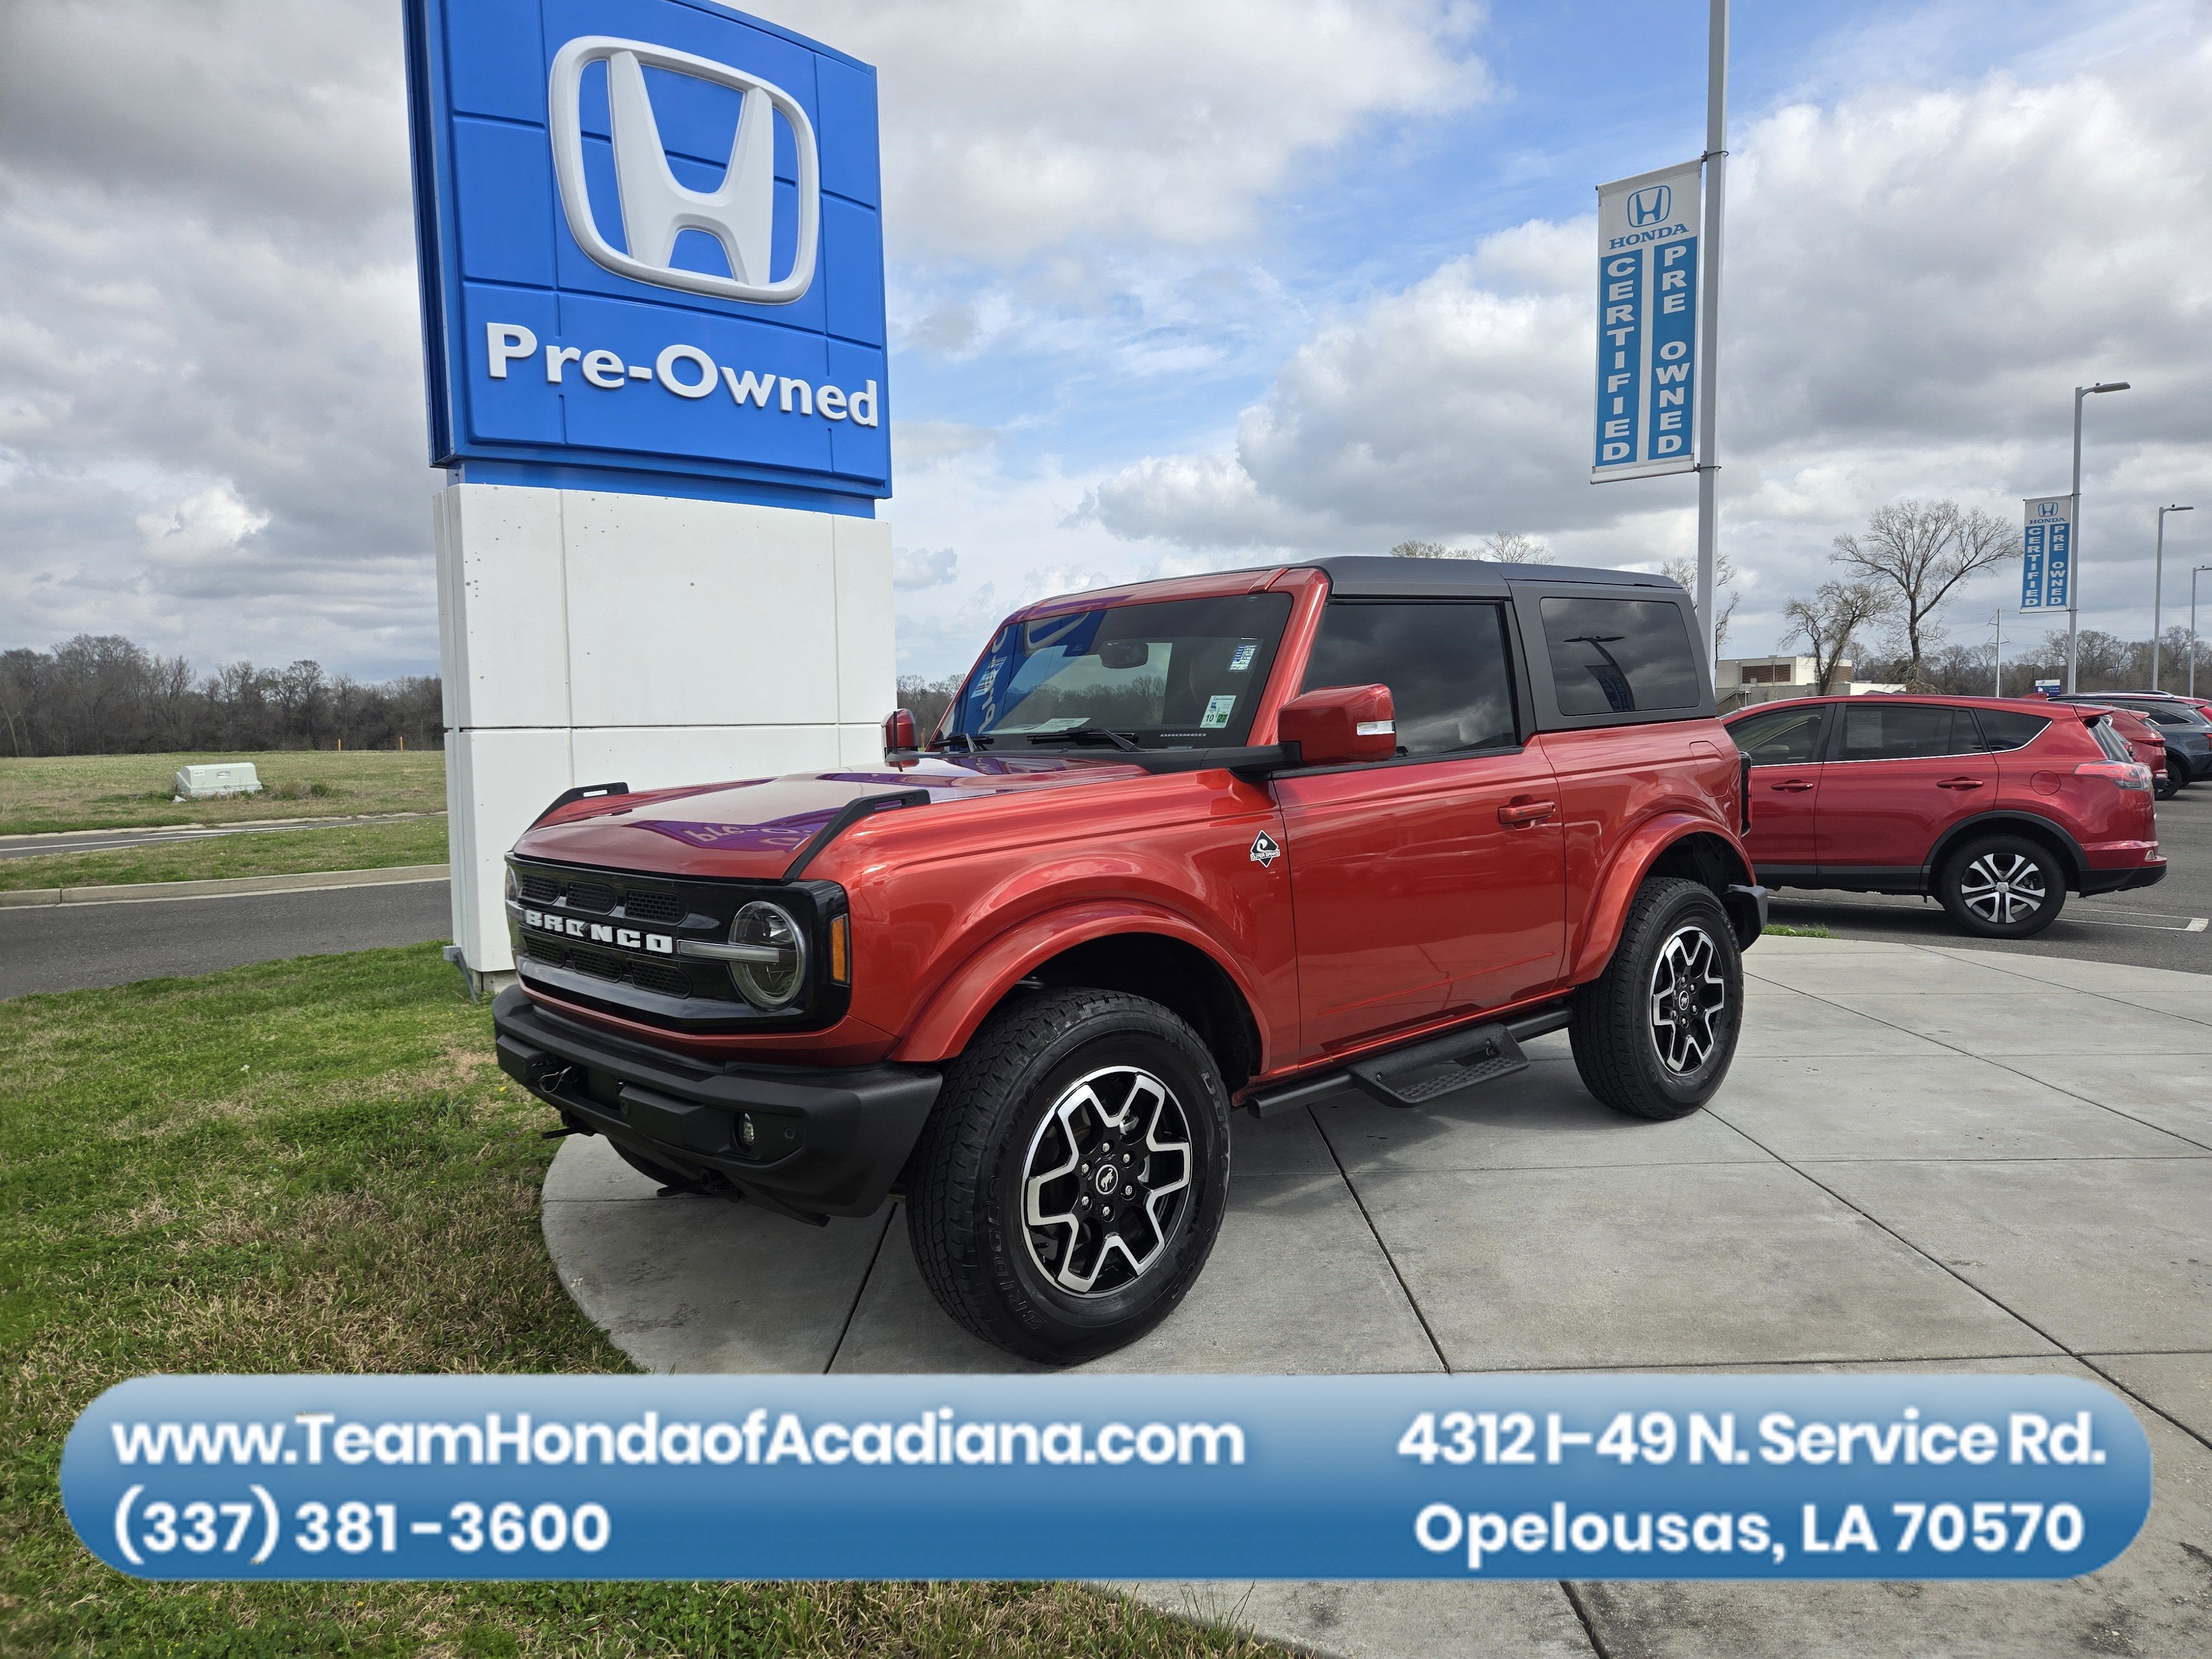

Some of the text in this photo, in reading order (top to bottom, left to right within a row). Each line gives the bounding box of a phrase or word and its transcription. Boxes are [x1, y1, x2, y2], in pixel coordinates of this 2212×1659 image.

[1609, 223, 1689, 250] HONDA
[486, 322, 878, 427] Pre-Owned
[1603, 257, 1636, 461] CERTIFIED
[1656, 246, 1691, 454] PRE OWNED
[2025, 528, 2042, 606] CERTIFIED
[2049, 526, 2065, 604] PRE OWNED
[1217, 714, 1227, 723] 27
[526, 910, 672, 953] BRONCO
